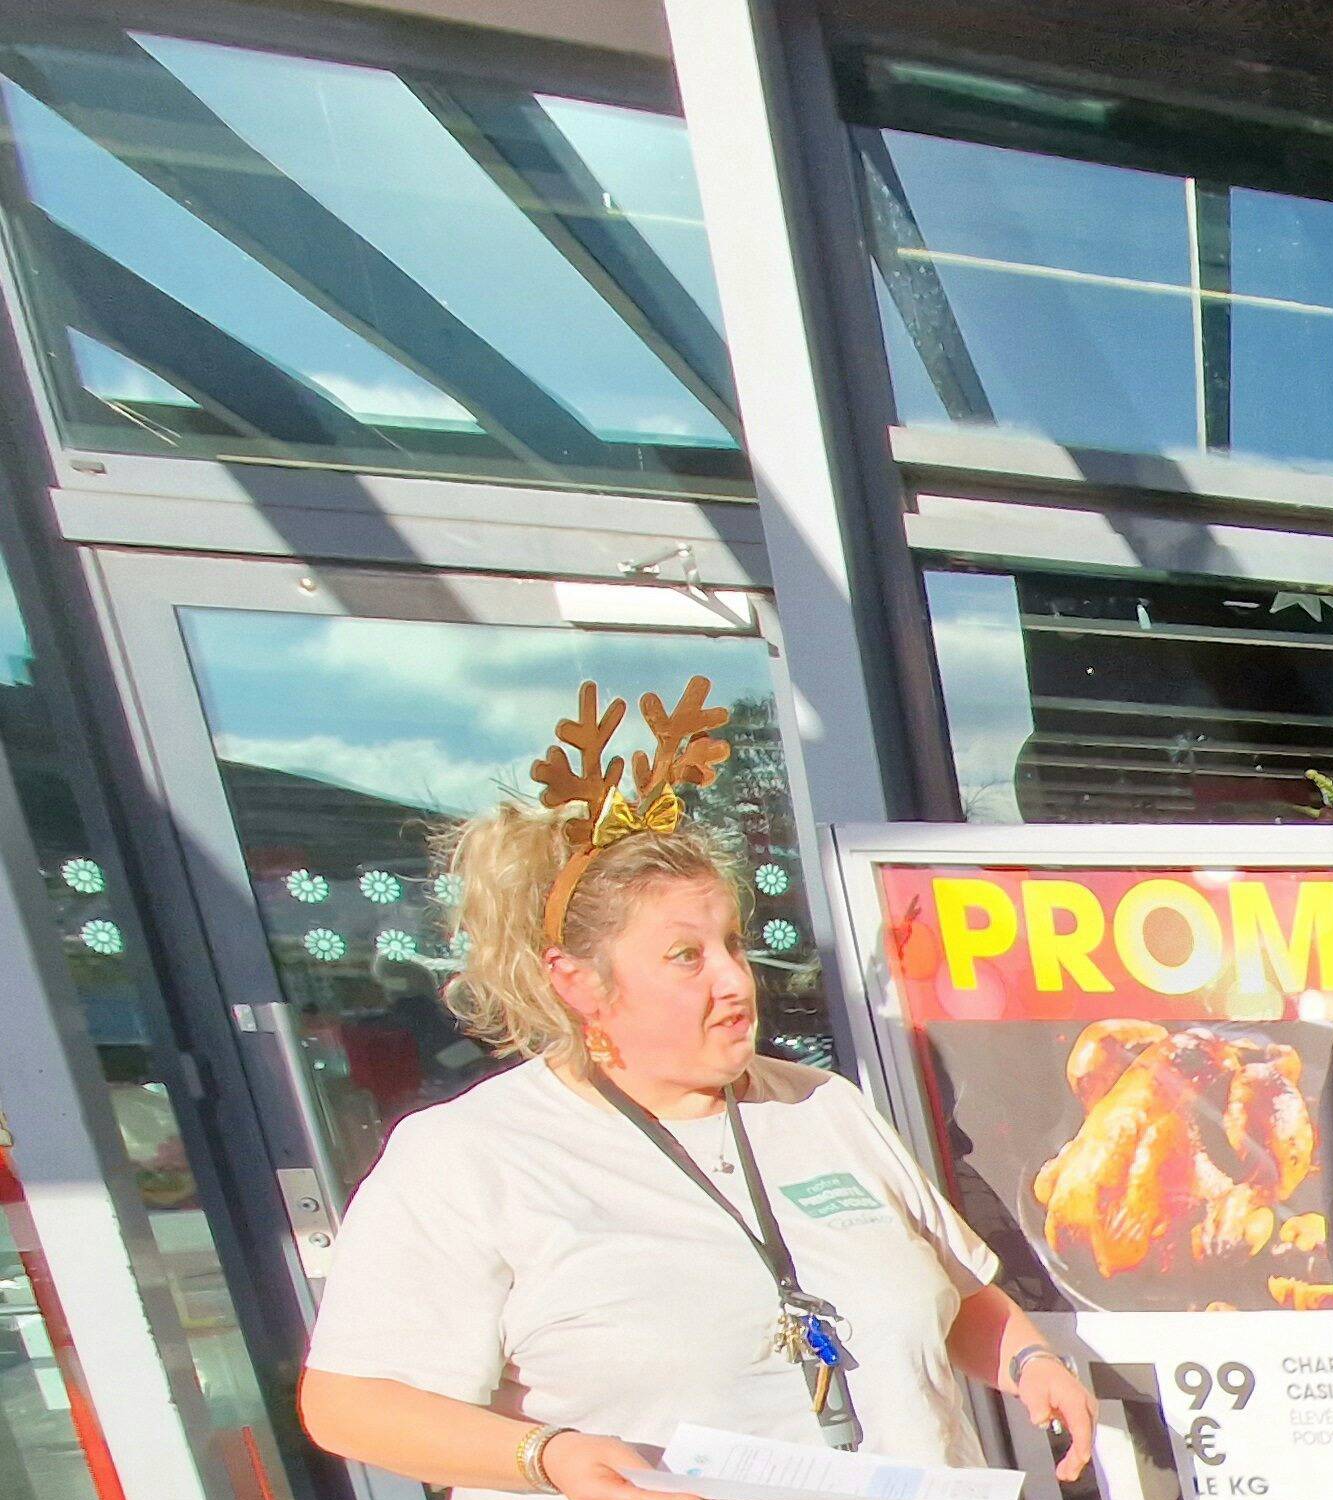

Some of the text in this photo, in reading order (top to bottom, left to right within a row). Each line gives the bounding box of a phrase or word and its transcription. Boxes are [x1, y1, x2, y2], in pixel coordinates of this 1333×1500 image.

[1174, 1361, 1256, 1410] 99
[1184, 1416, 1227, 1466] €
[1194, 1476, 1270, 1496] LE KG
